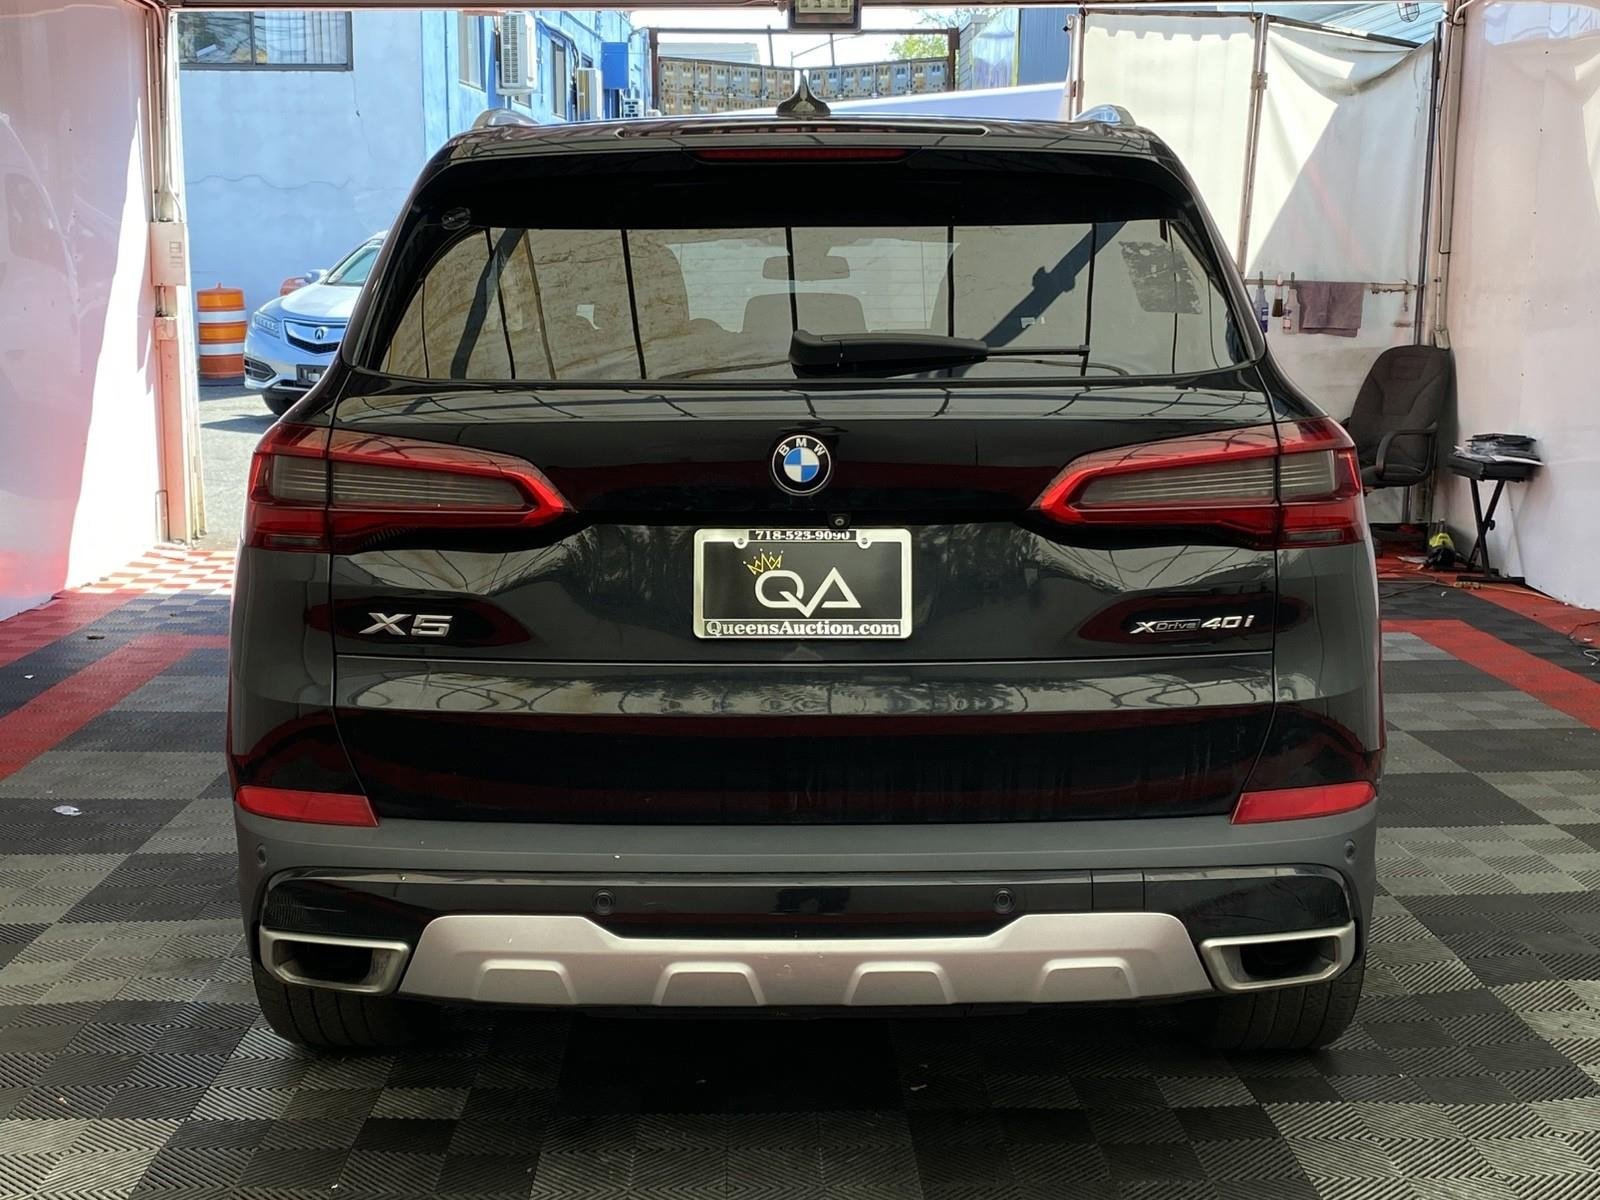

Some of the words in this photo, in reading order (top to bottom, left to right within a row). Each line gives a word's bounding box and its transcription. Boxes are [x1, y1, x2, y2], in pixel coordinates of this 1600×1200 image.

[778, 438, 826, 456] BMW
[755, 530, 850, 540] 718-523-9090
[755, 567, 862, 618] QA
[358, 612, 454, 637] X5
[706, 620, 900, 637] QueensAuction.com
[1201, 615, 1255, 630] 40i
